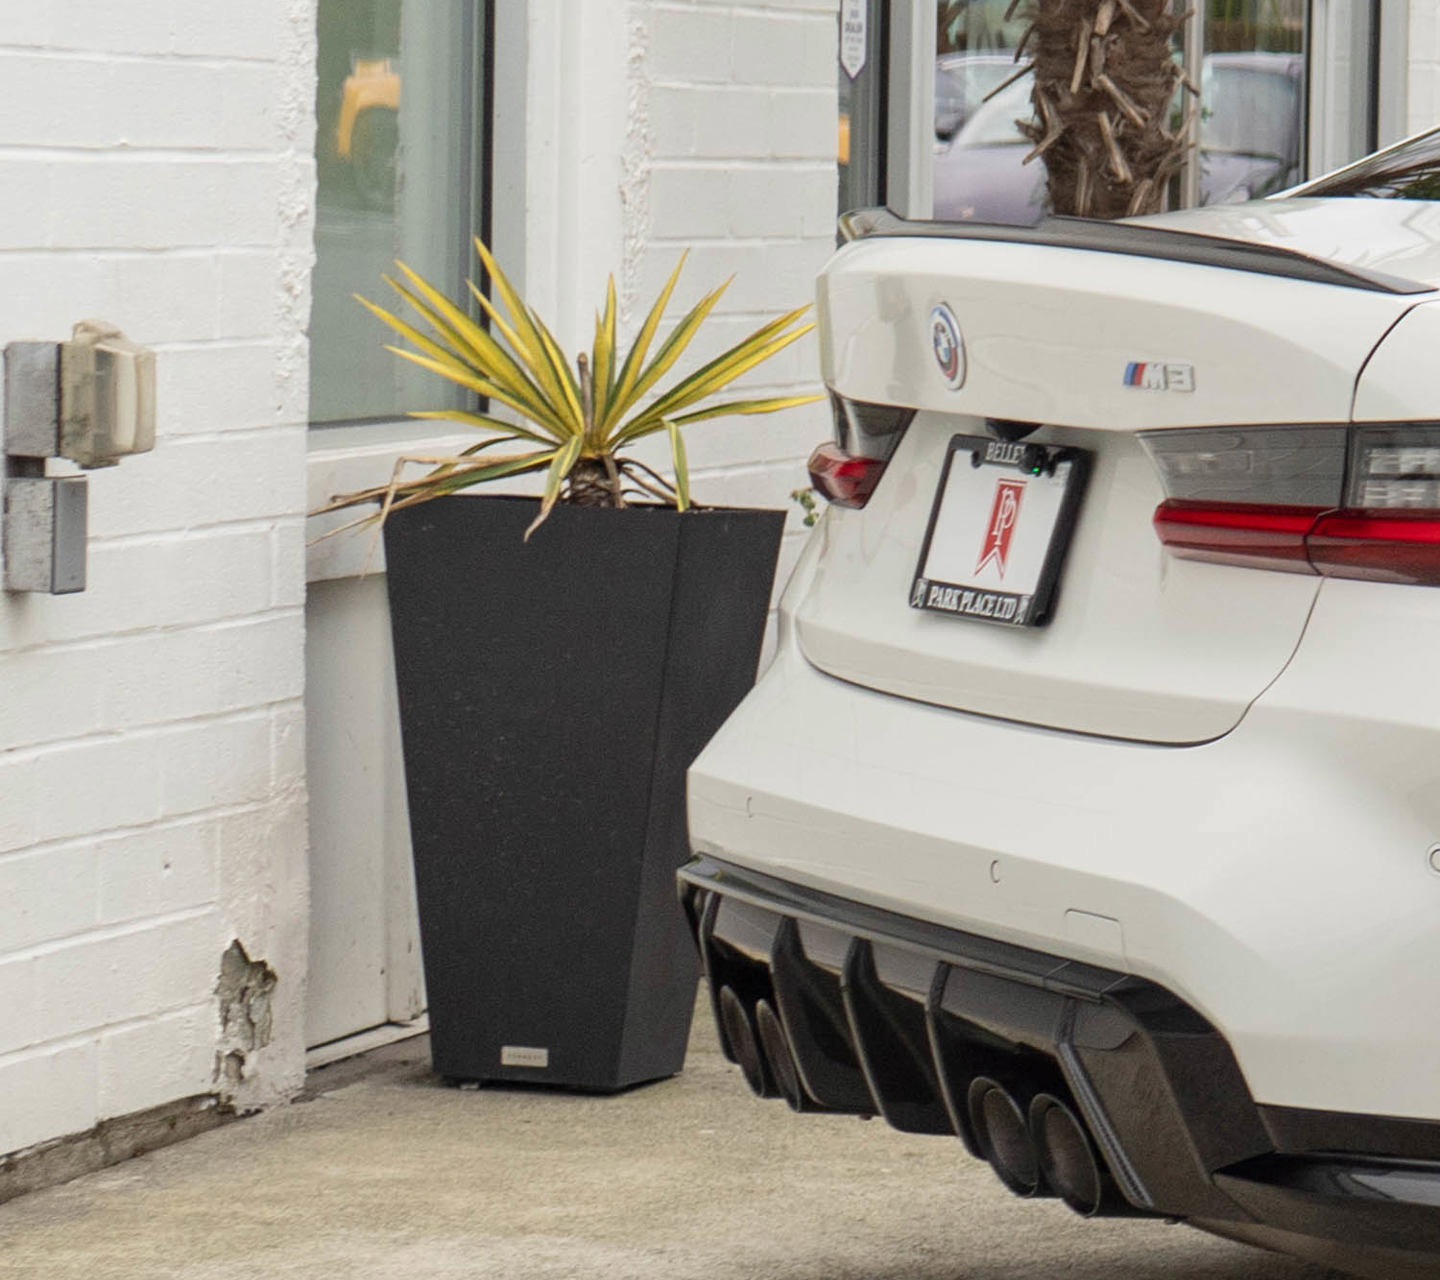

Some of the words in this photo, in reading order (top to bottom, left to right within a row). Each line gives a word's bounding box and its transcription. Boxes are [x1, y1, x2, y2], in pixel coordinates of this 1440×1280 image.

[1136, 362, 1195, 391] M3
[986, 442, 1026, 464] BELLE
[927, 585, 962, 611] PARK
[959, 591, 998, 616] PLACE
[993, 596, 1018, 619] LTD
